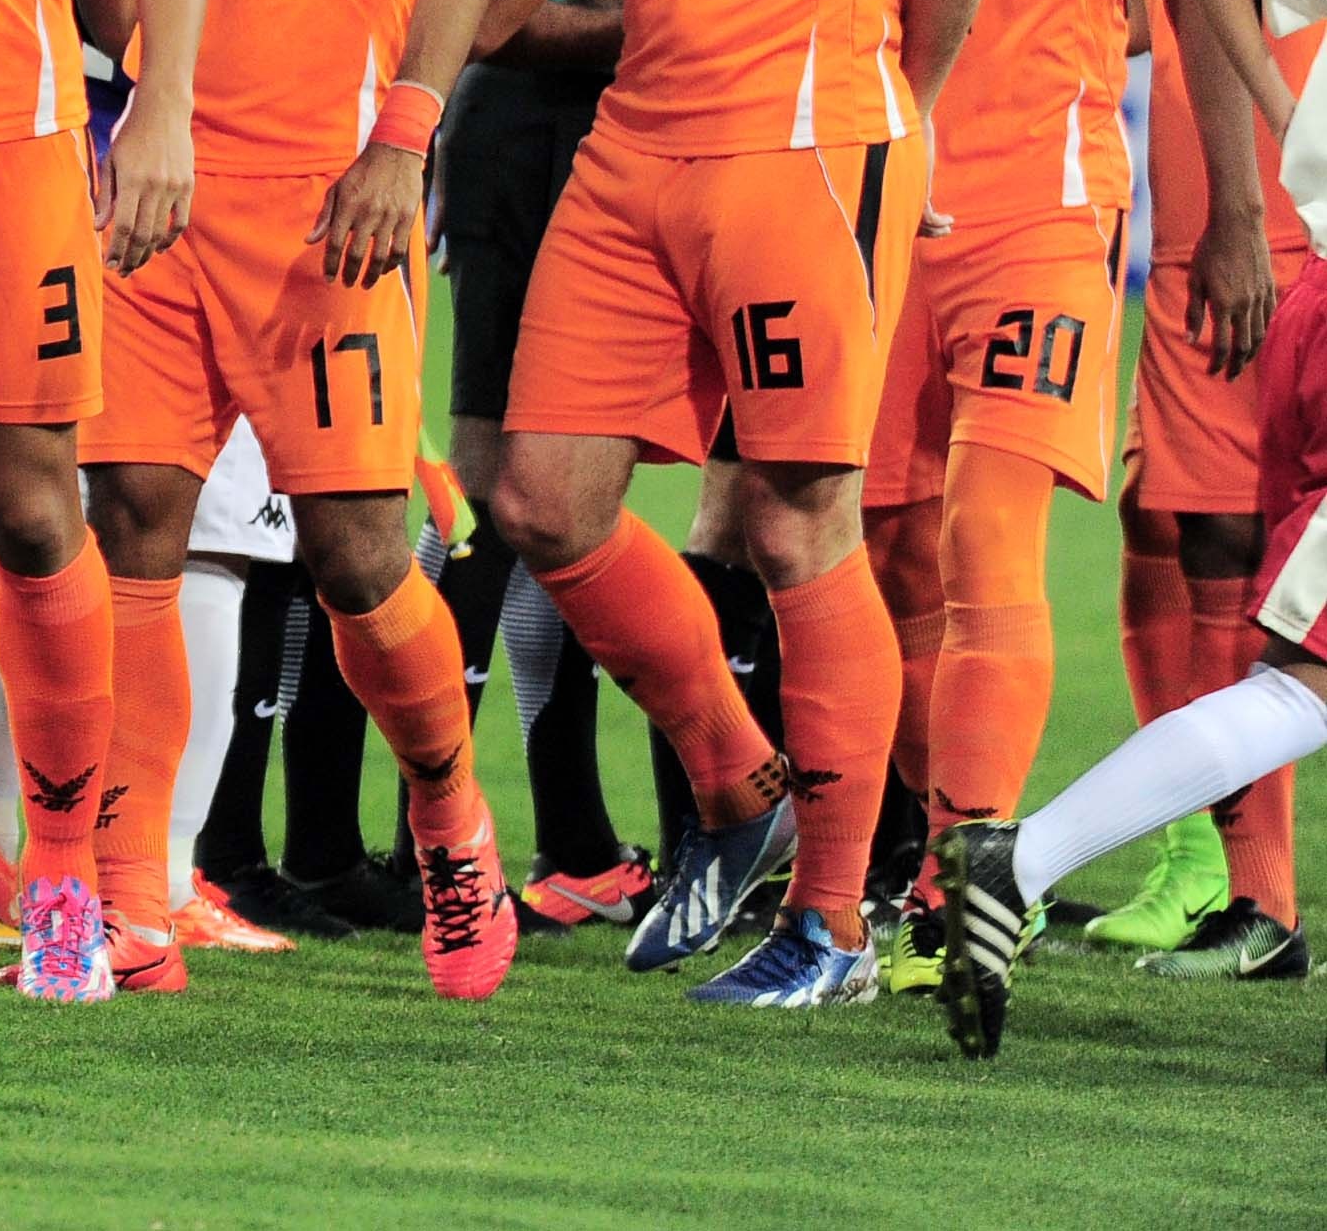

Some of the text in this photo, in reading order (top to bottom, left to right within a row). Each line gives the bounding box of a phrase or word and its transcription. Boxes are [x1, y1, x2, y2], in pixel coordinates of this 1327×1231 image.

[37, 264, 82, 362] 3
[731, 299, 804, 391] 16
[982, 308, 1087, 405] 20
[310, 333, 385, 430] 17
